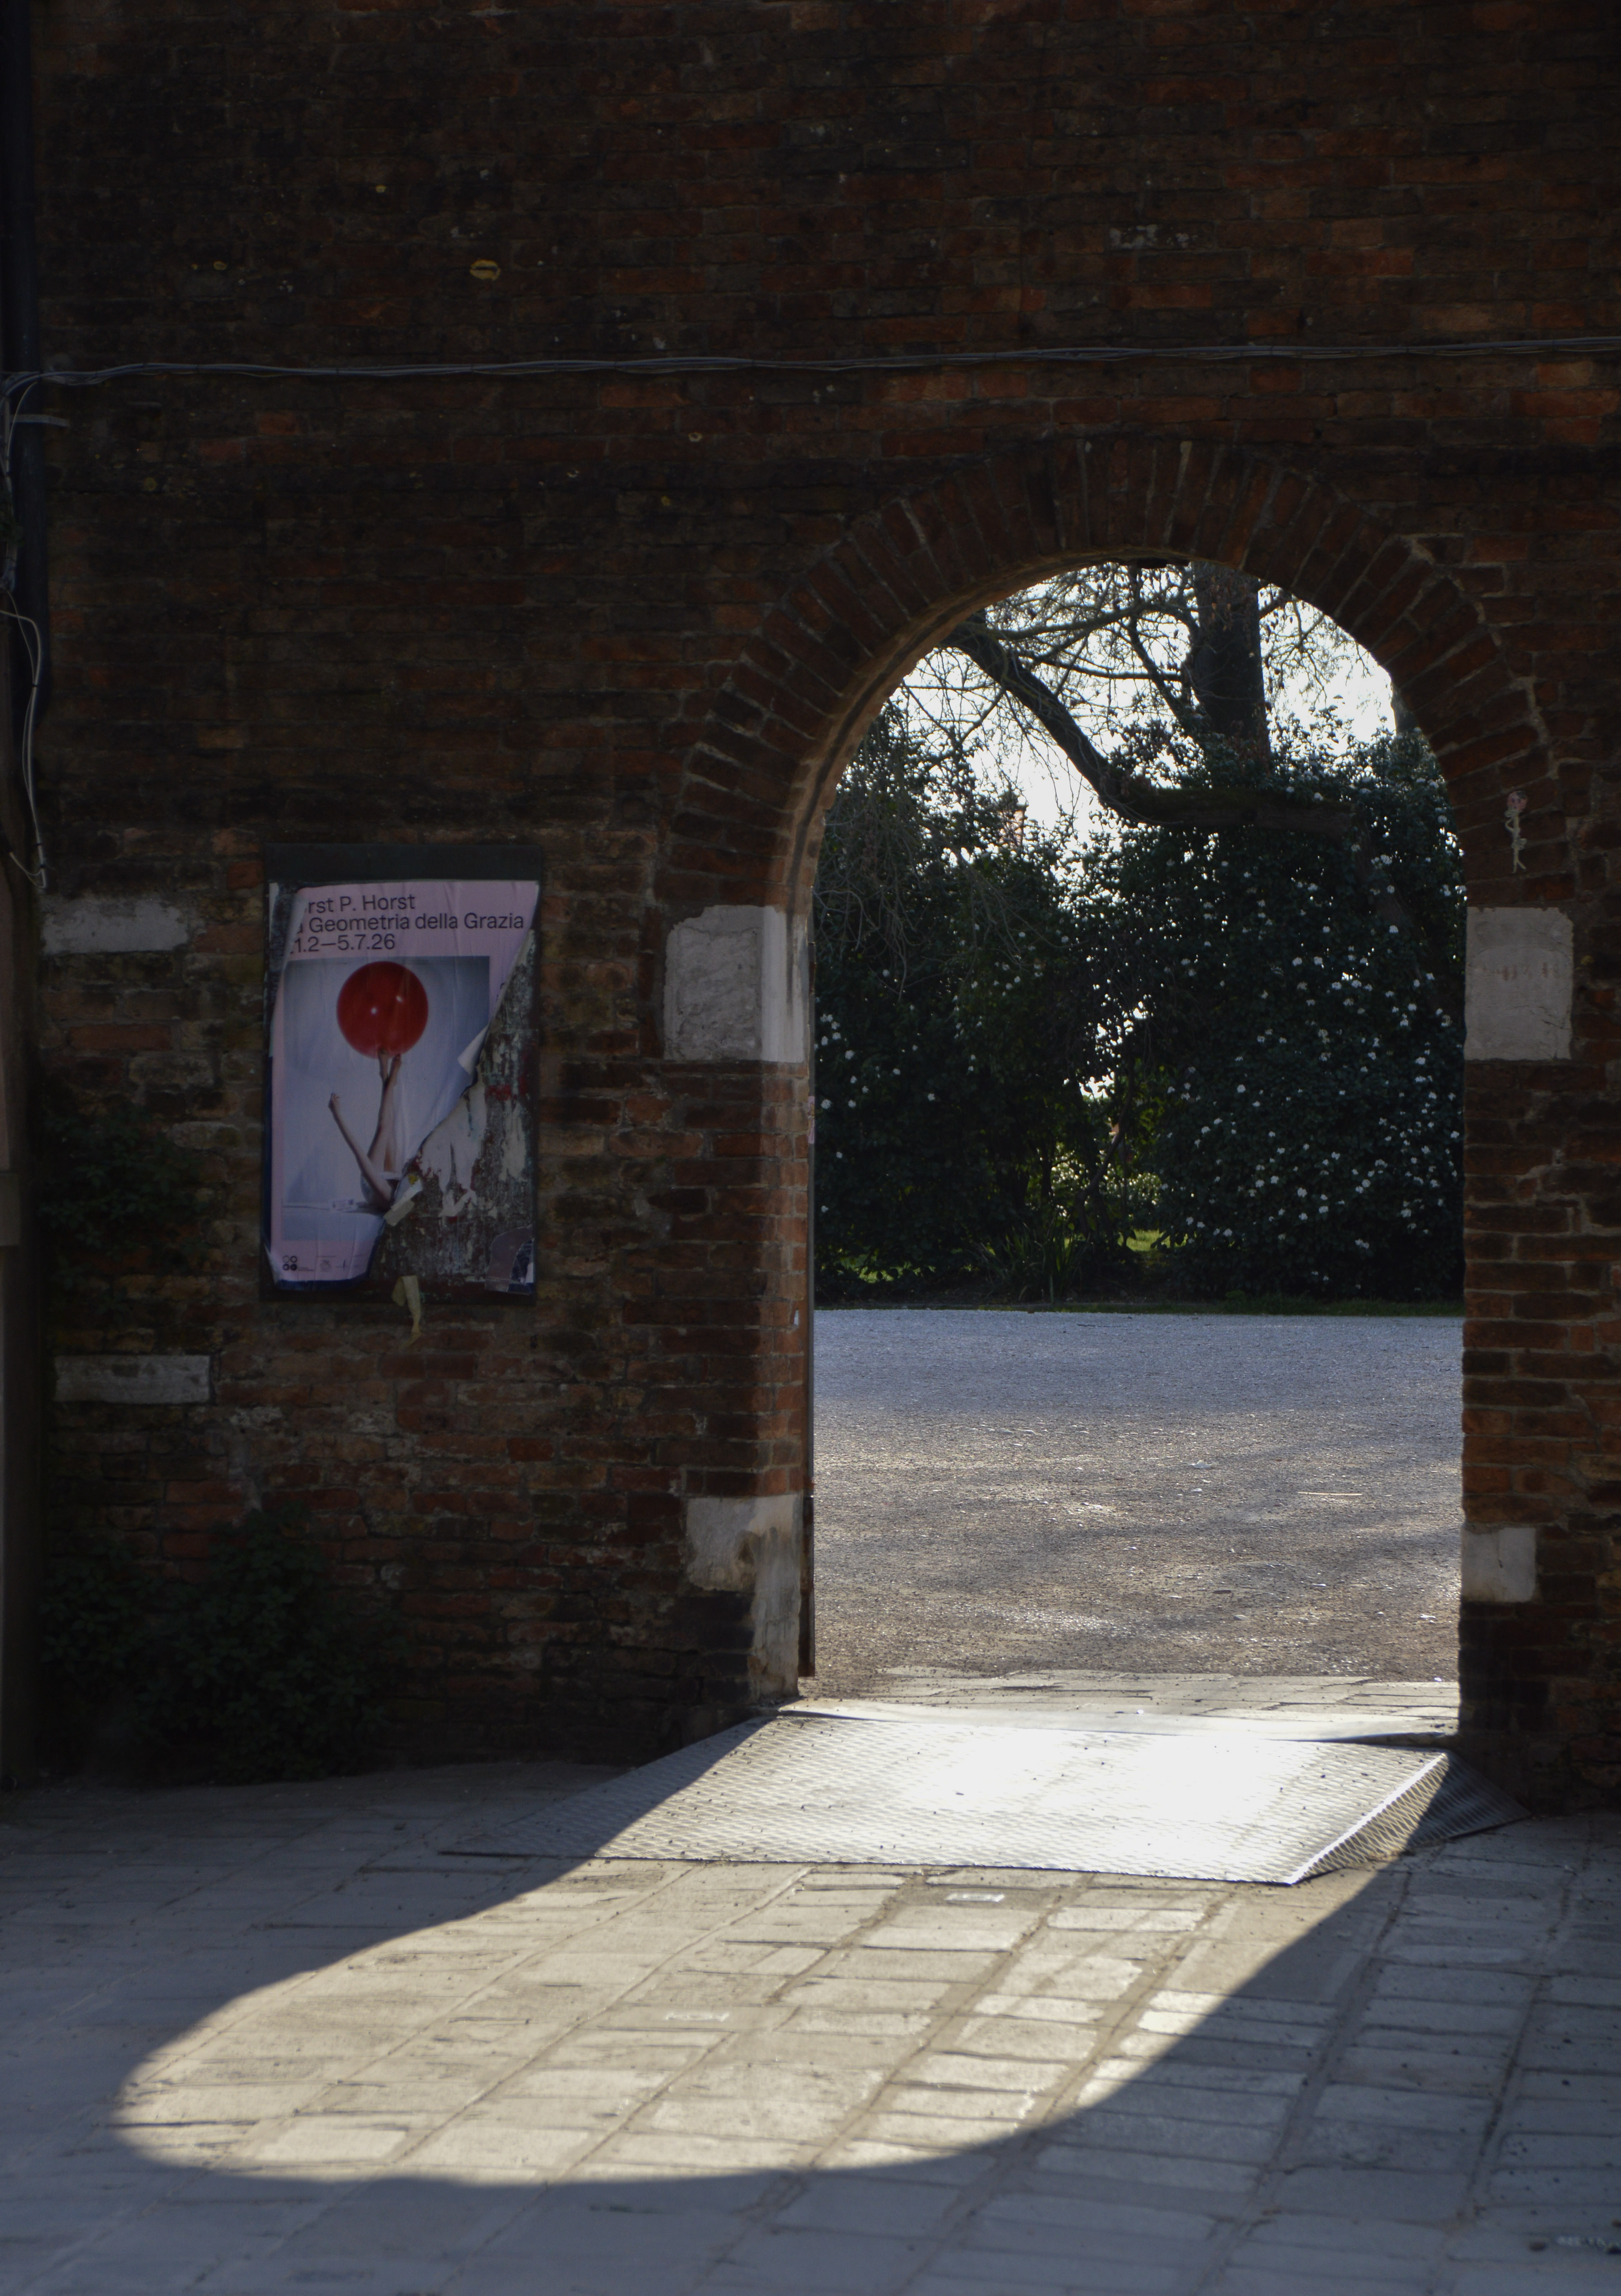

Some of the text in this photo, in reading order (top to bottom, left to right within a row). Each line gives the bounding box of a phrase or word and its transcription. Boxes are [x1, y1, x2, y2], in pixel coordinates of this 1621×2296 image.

[304, 894, 415, 914] rst P. Horst
[309, 913, 409, 933] Geometria
[415, 913, 458, 929] della
[464, 912, 524, 929] Grazia
